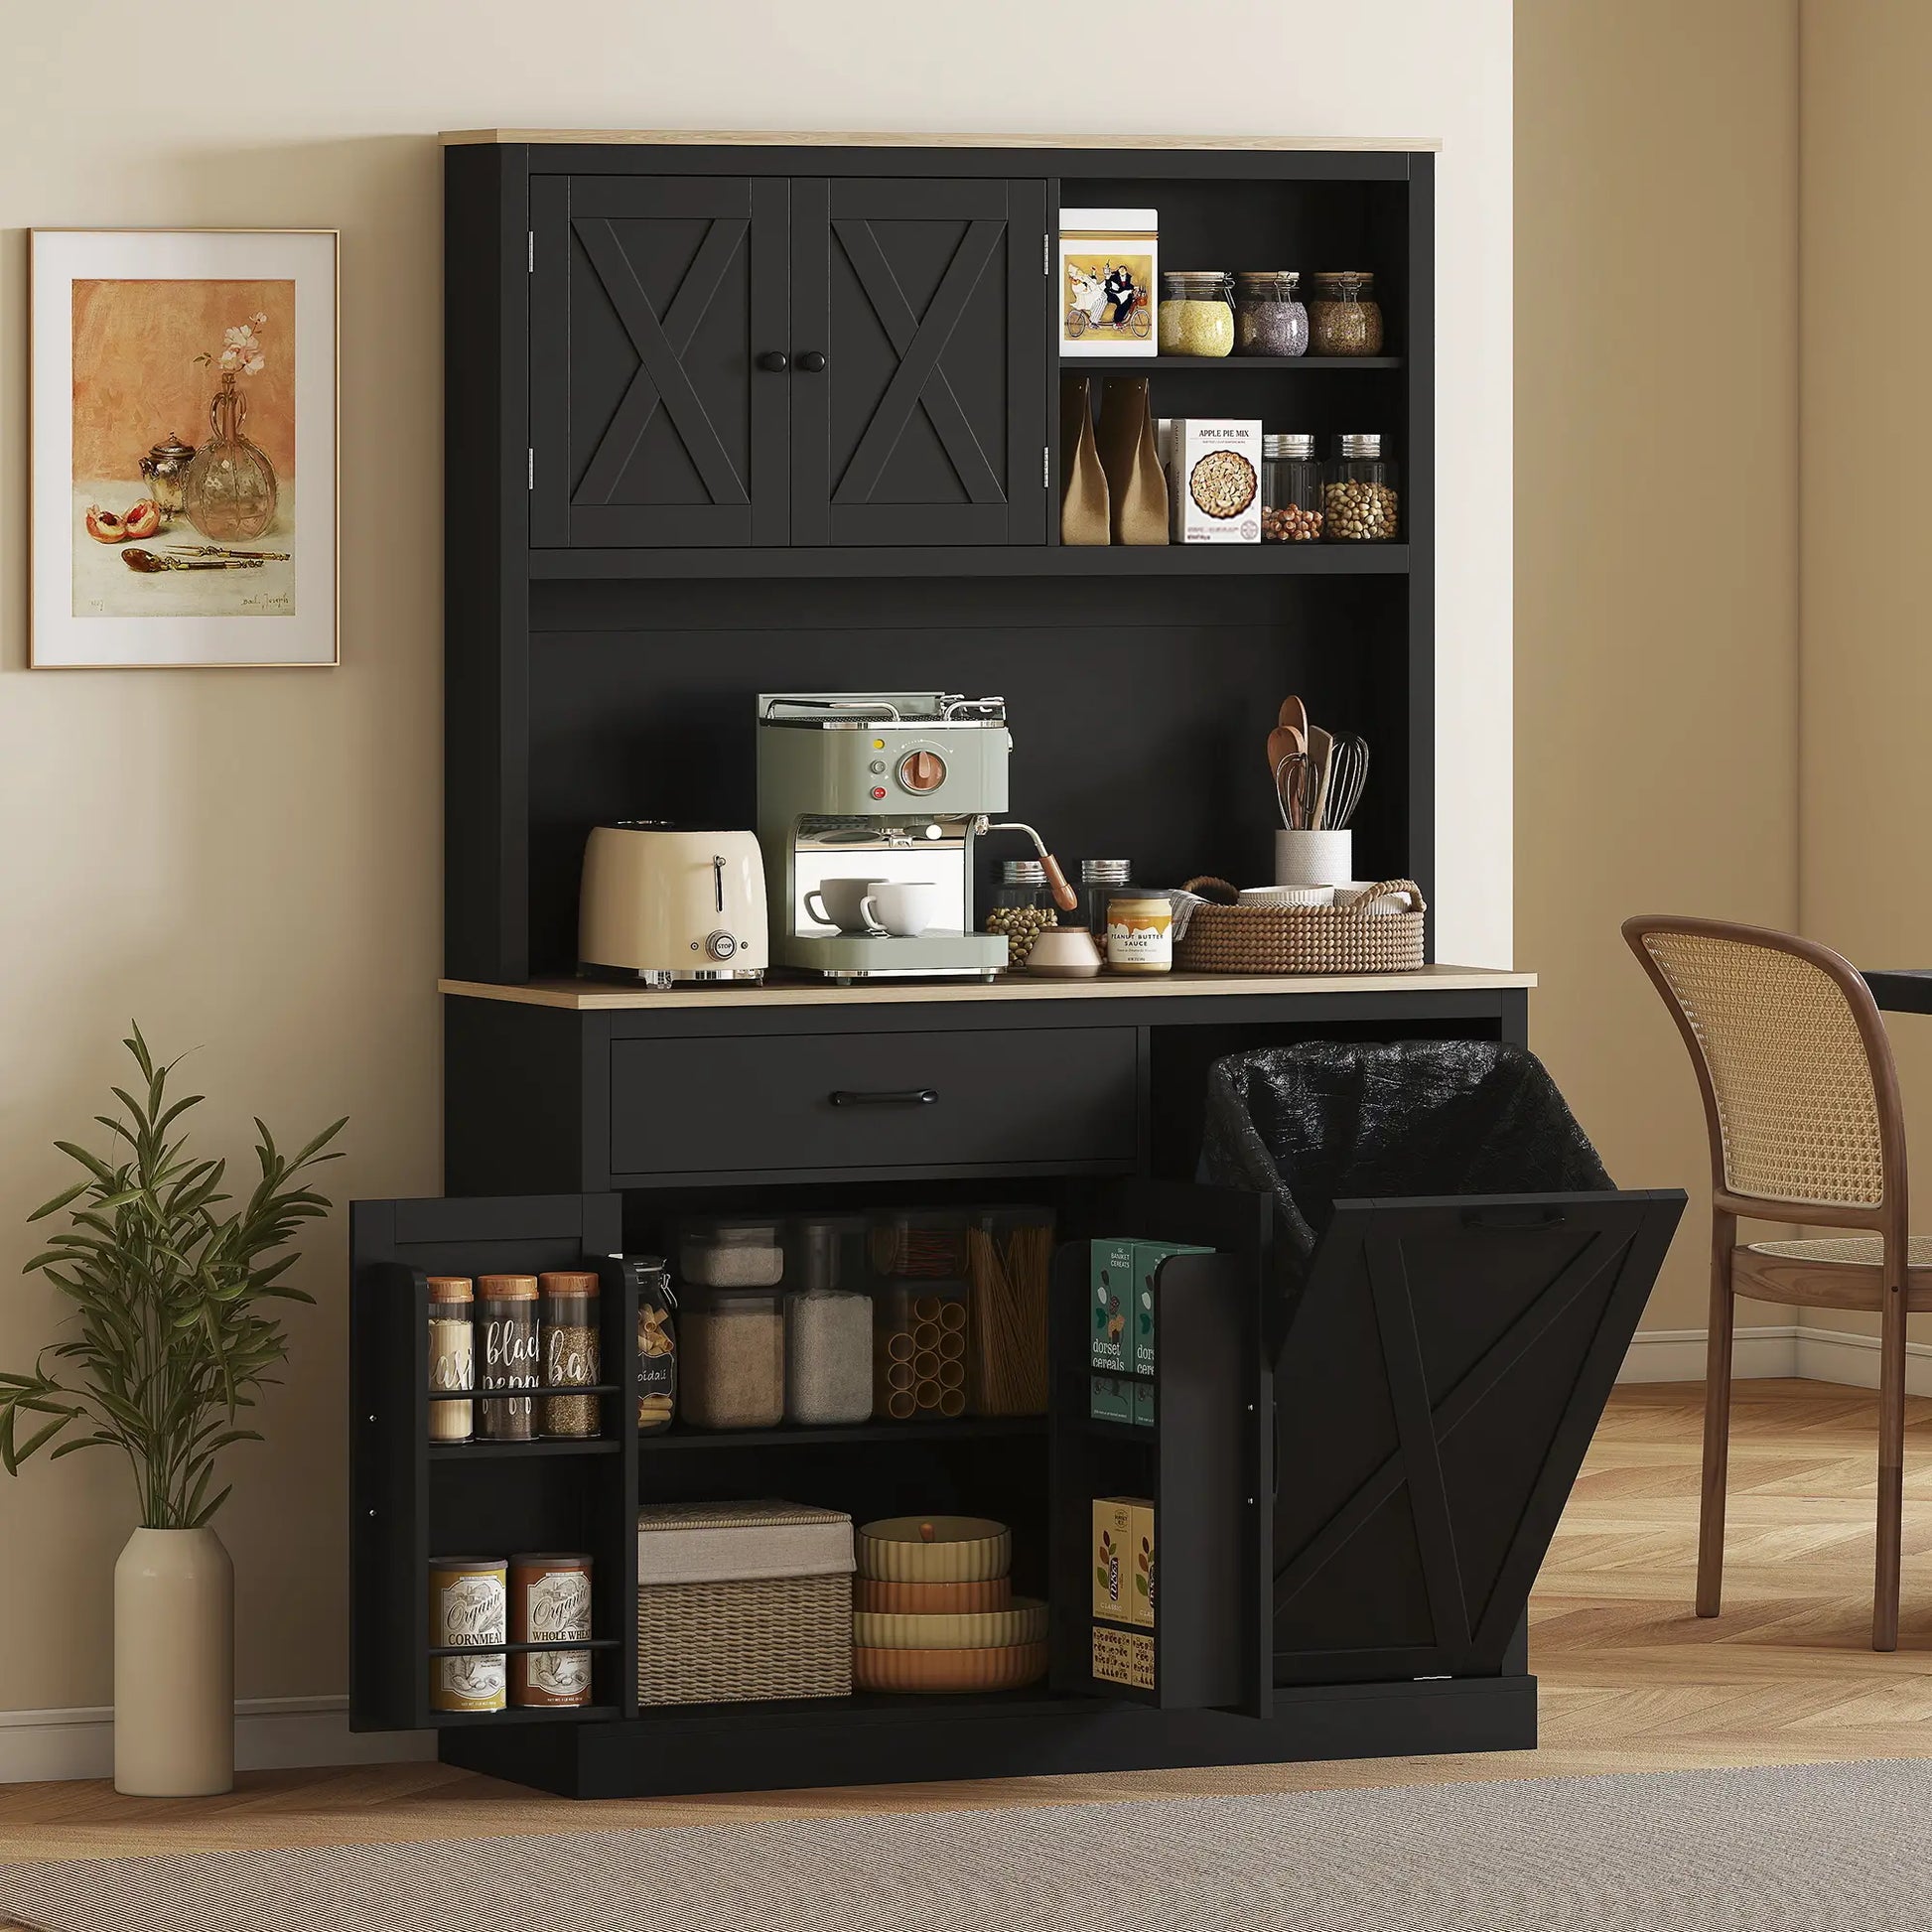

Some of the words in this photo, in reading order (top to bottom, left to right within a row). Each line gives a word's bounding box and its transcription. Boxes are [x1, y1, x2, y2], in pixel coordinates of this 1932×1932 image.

[1093, 1338, 1121, 1356] dorset
[1093, 1357, 1125, 1371] cereals
[447, 1588, 502, 1632] Organic
[533, 1585, 588, 1633] Organic
[1100, 1602, 1122, 1611] CLASSIC
[448, 1632, 503, 1645] CORNMEAL
[532, 1630, 567, 1641] WHOLE
